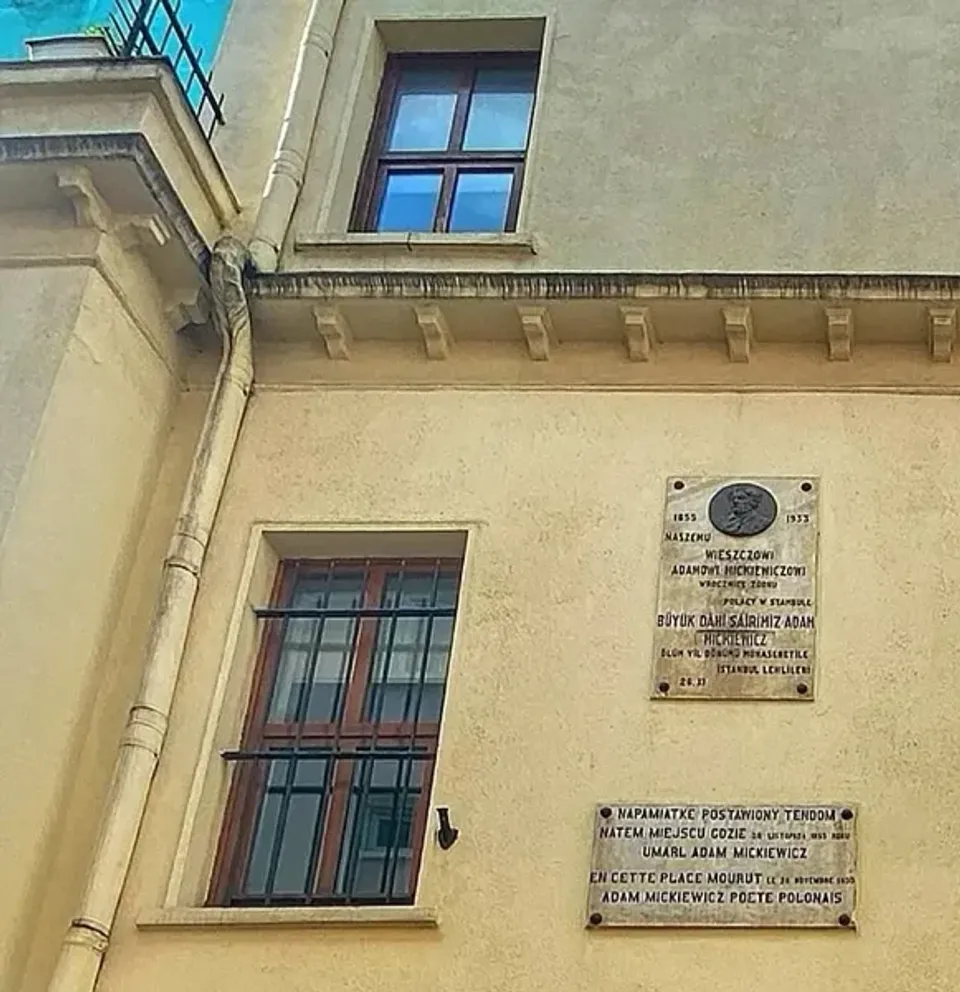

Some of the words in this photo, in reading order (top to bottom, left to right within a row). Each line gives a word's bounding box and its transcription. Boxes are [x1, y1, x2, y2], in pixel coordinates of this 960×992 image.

[665, 532, 712, 542] NASZEMU
[705, 549, 774, 560] WIESZCZOWI
[701, 809, 780, 820] POSTAWIONY
[784, 810, 836, 821] TENDOM
[600, 827, 644, 839] NATEM
[649, 828, 705, 839] MIEJSCU
[710, 828, 746, 839] GDZIE
[691, 846, 727, 858] ADAM
[733, 847, 808, 858] MICKIEWICZ
[589, 872, 607, 883] EN
[611, 872, 656, 883] CETTE
[660, 872, 703, 883] PLACE
[707, 872, 763, 884] MOURUT
[601, 891, 640, 903] ADAM
[645, 891, 725, 903] MICKIEWICZ
[730, 892, 774, 903] POETE
[778, 892, 843, 904] POLONAIS
